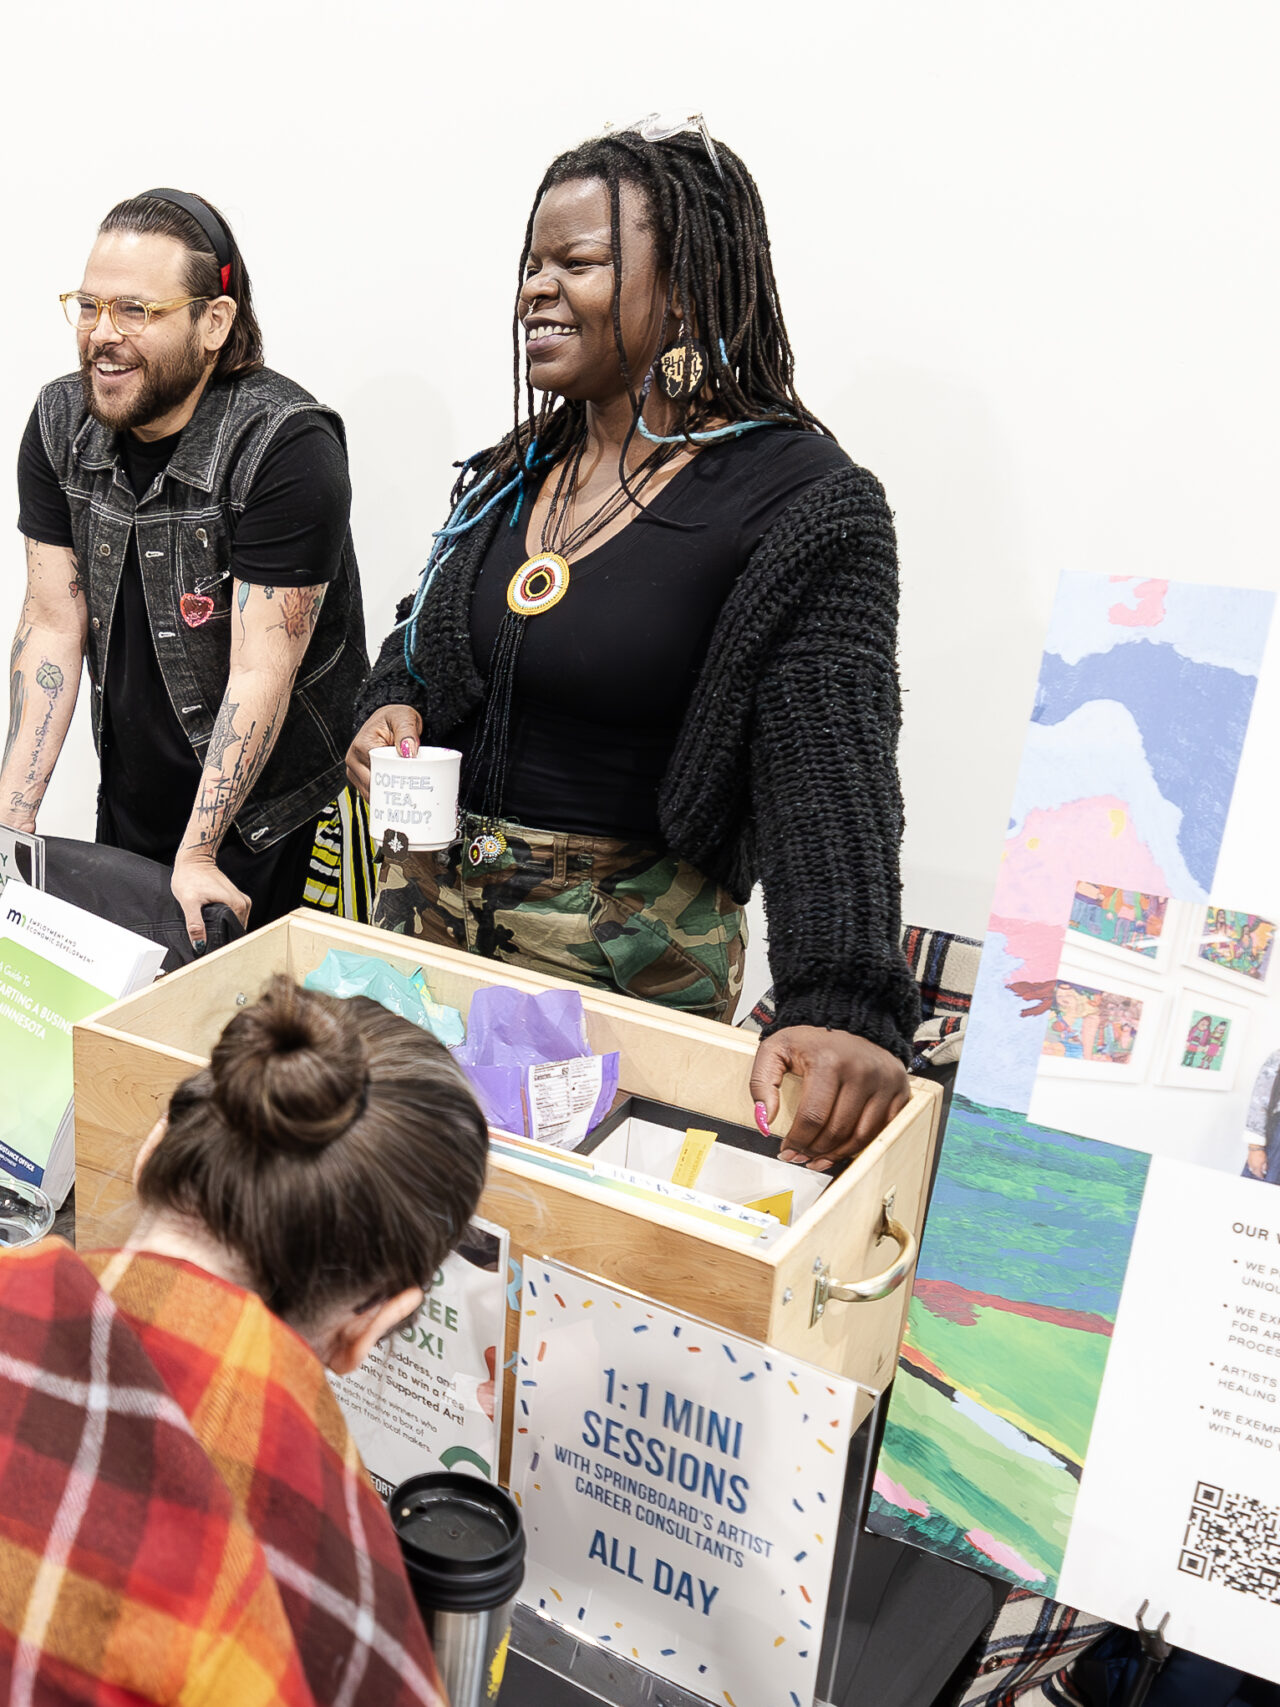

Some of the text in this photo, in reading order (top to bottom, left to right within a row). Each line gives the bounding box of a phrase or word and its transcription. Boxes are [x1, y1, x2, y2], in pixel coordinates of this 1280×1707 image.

[374, 772, 434, 793] COFFEE,
[383, 791, 417, 810] TEA,
[386, 808, 432, 826] MUD?
[26, 924, 95, 965] ECONOMIC DEVELOPMENT
[29, 918, 77, 948] EMPLOYMENT AND
[3, 964, 23, 982] Guide
[22, 974, 31, 987] To
[31, 1002, 40, 1015] A
[39, 1006, 74, 1036] BUSINE
[1232, 1222, 1270, 1241] OUR
[1245, 1260, 1266, 1275] WE
[1235, 1305, 1256, 1319] WE
[1231, 1320, 1259, 1334] FOR
[400, 1325, 444, 1361] OX!
[368, 1353, 465, 1412] ance to win a free
[436, 1375, 456, 1391] and
[1221, 1364, 1278, 1388] ARTISTS
[345, 1376, 367, 1392] draw
[389, 1399, 419, 1423] winners
[420, 1418, 438, 1433] who
[360, 1362, 465, 1427] unity Supported Art!
[1218, 1378, 1277, 1404] HEALING
[343, 1387, 361, 1401] each
[362, 1398, 391, 1417] receive
[392, 1414, 399, 1422] a
[399, 1416, 414, 1431] box
[415, 1426, 425, 1437] of
[603, 1367, 744, 1460] 1:1 MINI
[1212, 1407, 1232, 1421] WE
[363, 1408, 381, 1422] from
[382, 1420, 401, 1436] local
[402, 1432, 433, 1454] makers.
[1208, 1421, 1241, 1439] WITH
[1245, 1433, 1273, 1449] AND
[581, 1409, 750, 1515] SESSIONS
[371, 1474, 395, 1497] ORT
[554, 1443, 775, 1559] WITH SPRINGBOARD'S ARTIST
[575, 1476, 745, 1569] CAREER CONSULTANTS
[587, 1528, 720, 1617] ALL DAY
